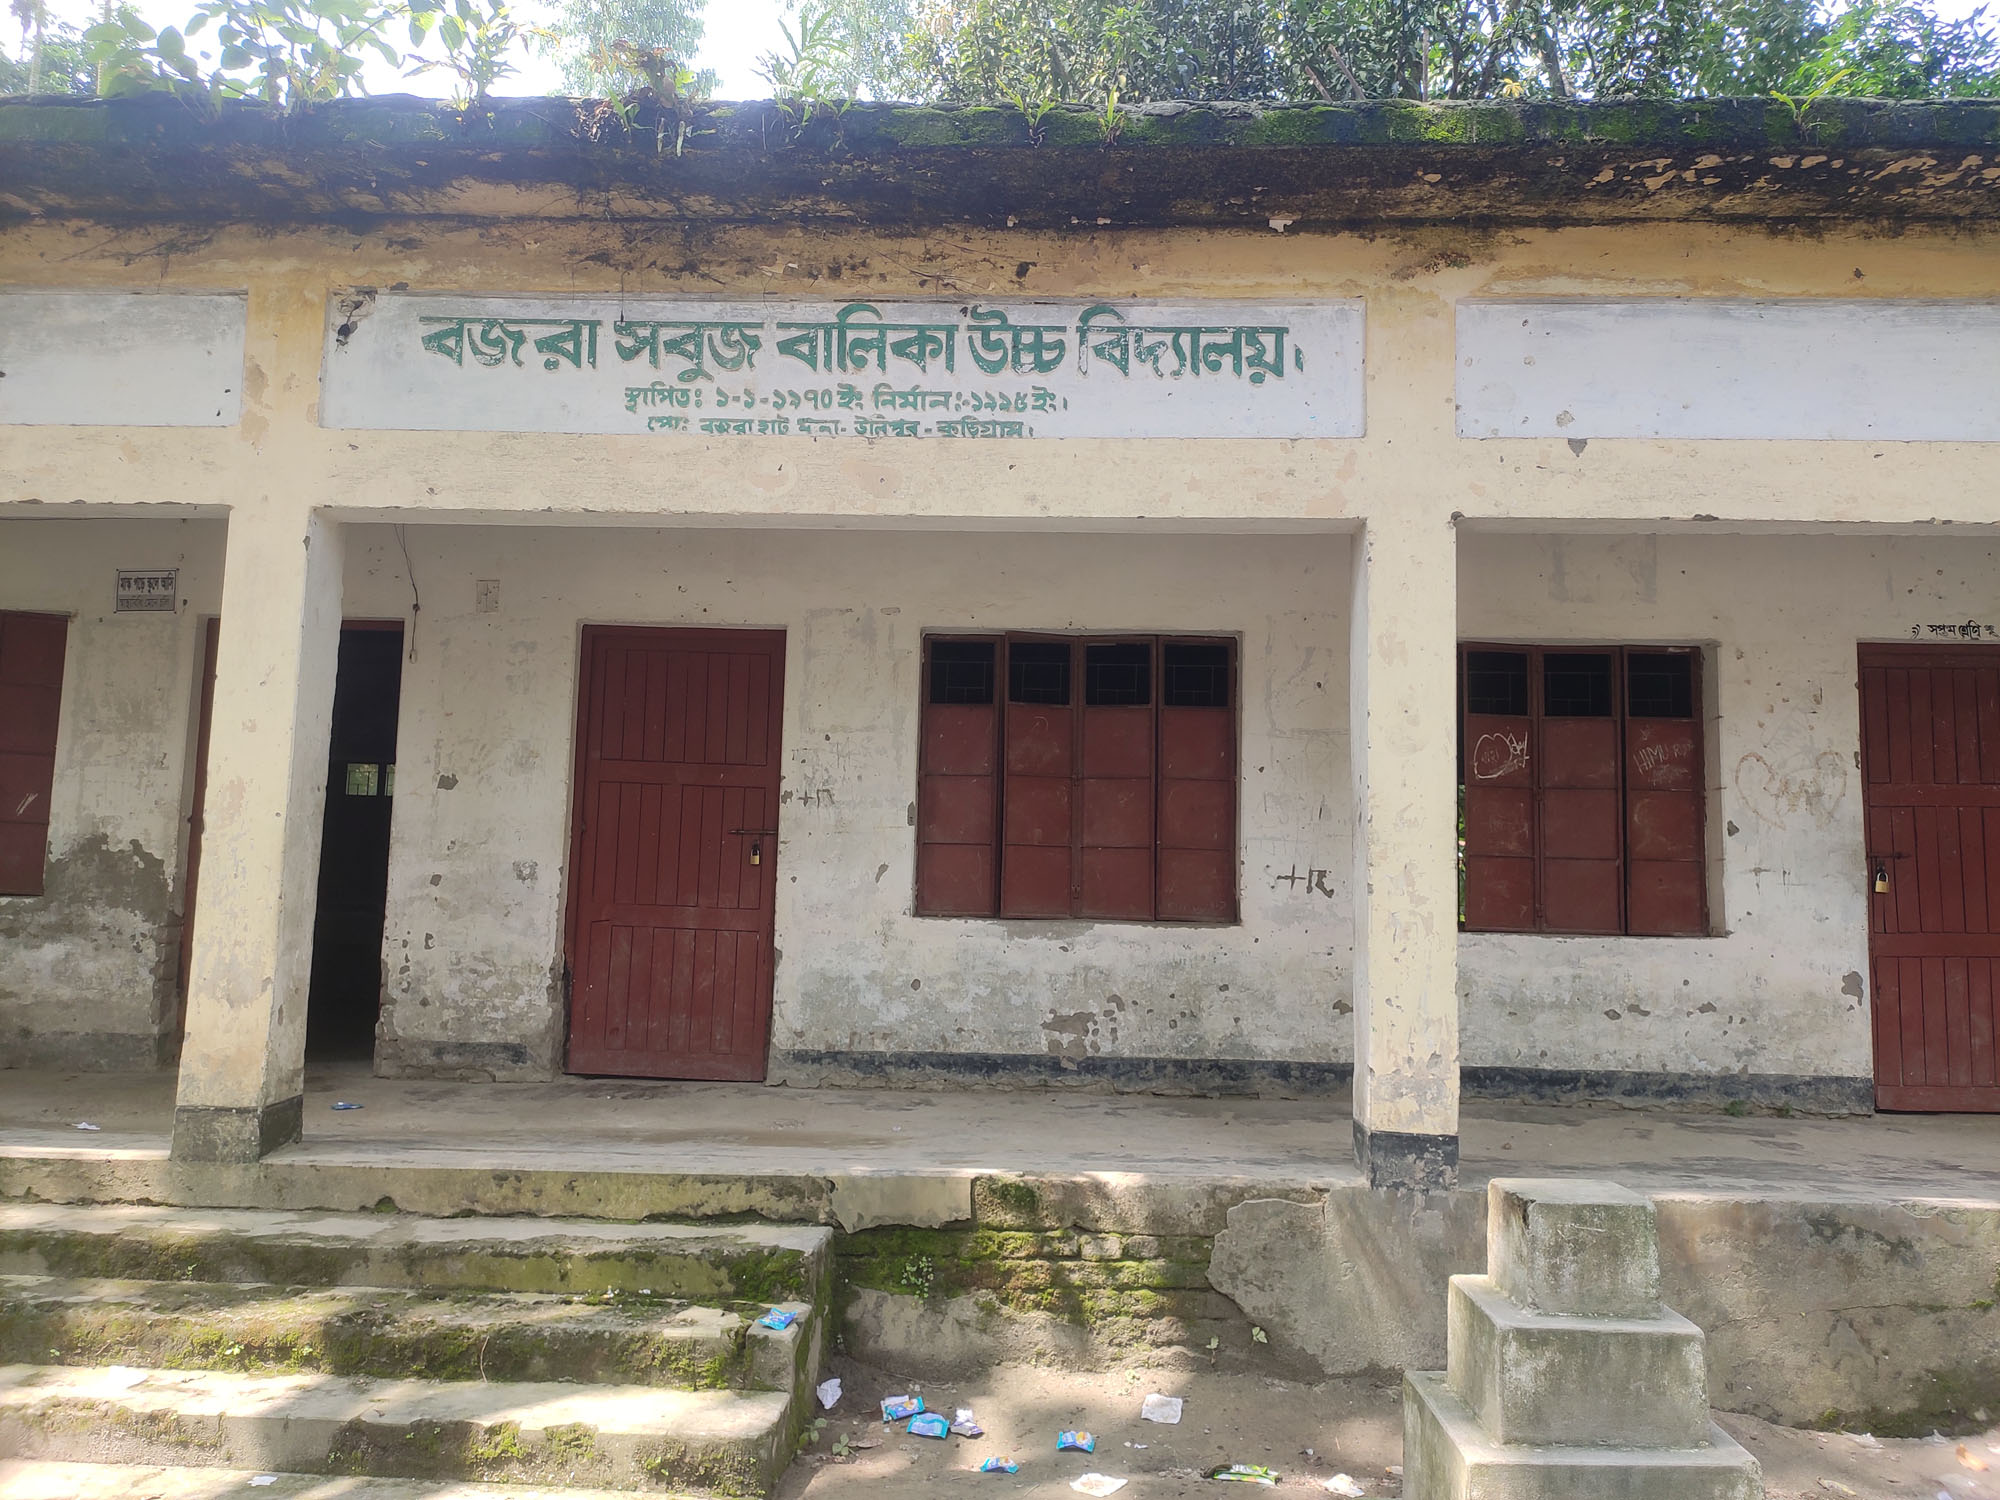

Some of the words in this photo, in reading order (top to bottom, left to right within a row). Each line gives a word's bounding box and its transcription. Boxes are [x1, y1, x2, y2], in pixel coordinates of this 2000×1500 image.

[419, 316, 603, 371] বজরা
[613, 320, 764, 383] সবুজ
[776, 303, 958, 374] বালিকা
[968, 304, 1066, 376] উচ্চ
